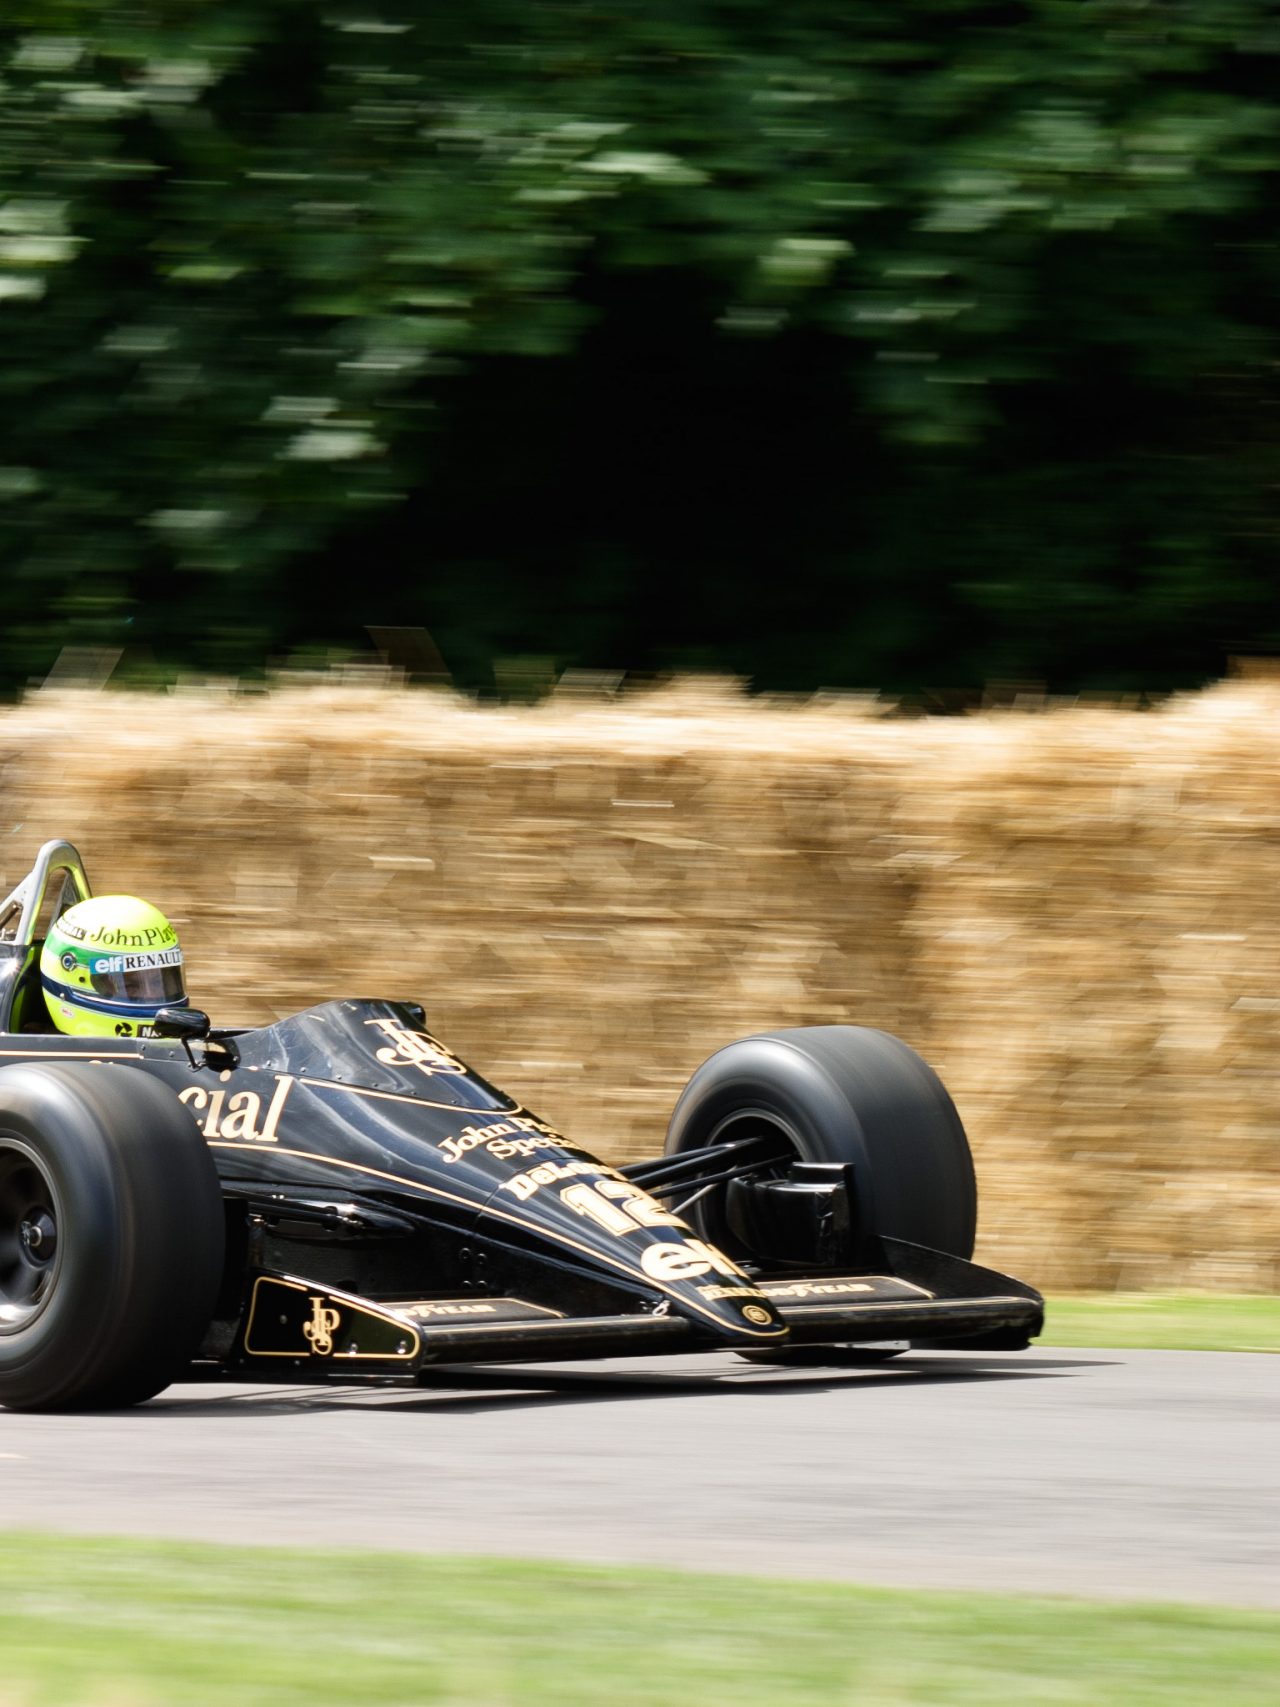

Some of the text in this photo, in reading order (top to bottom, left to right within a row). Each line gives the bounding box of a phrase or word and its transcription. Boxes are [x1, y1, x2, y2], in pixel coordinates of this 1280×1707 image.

[90, 926, 144, 947] John
[95, 955, 124, 973] elf
[125, 951, 182, 968] RENAULT
[177, 1069, 295, 1143] cial
[437, 1121, 518, 1164] John
[560, 1180, 692, 1237] 12
